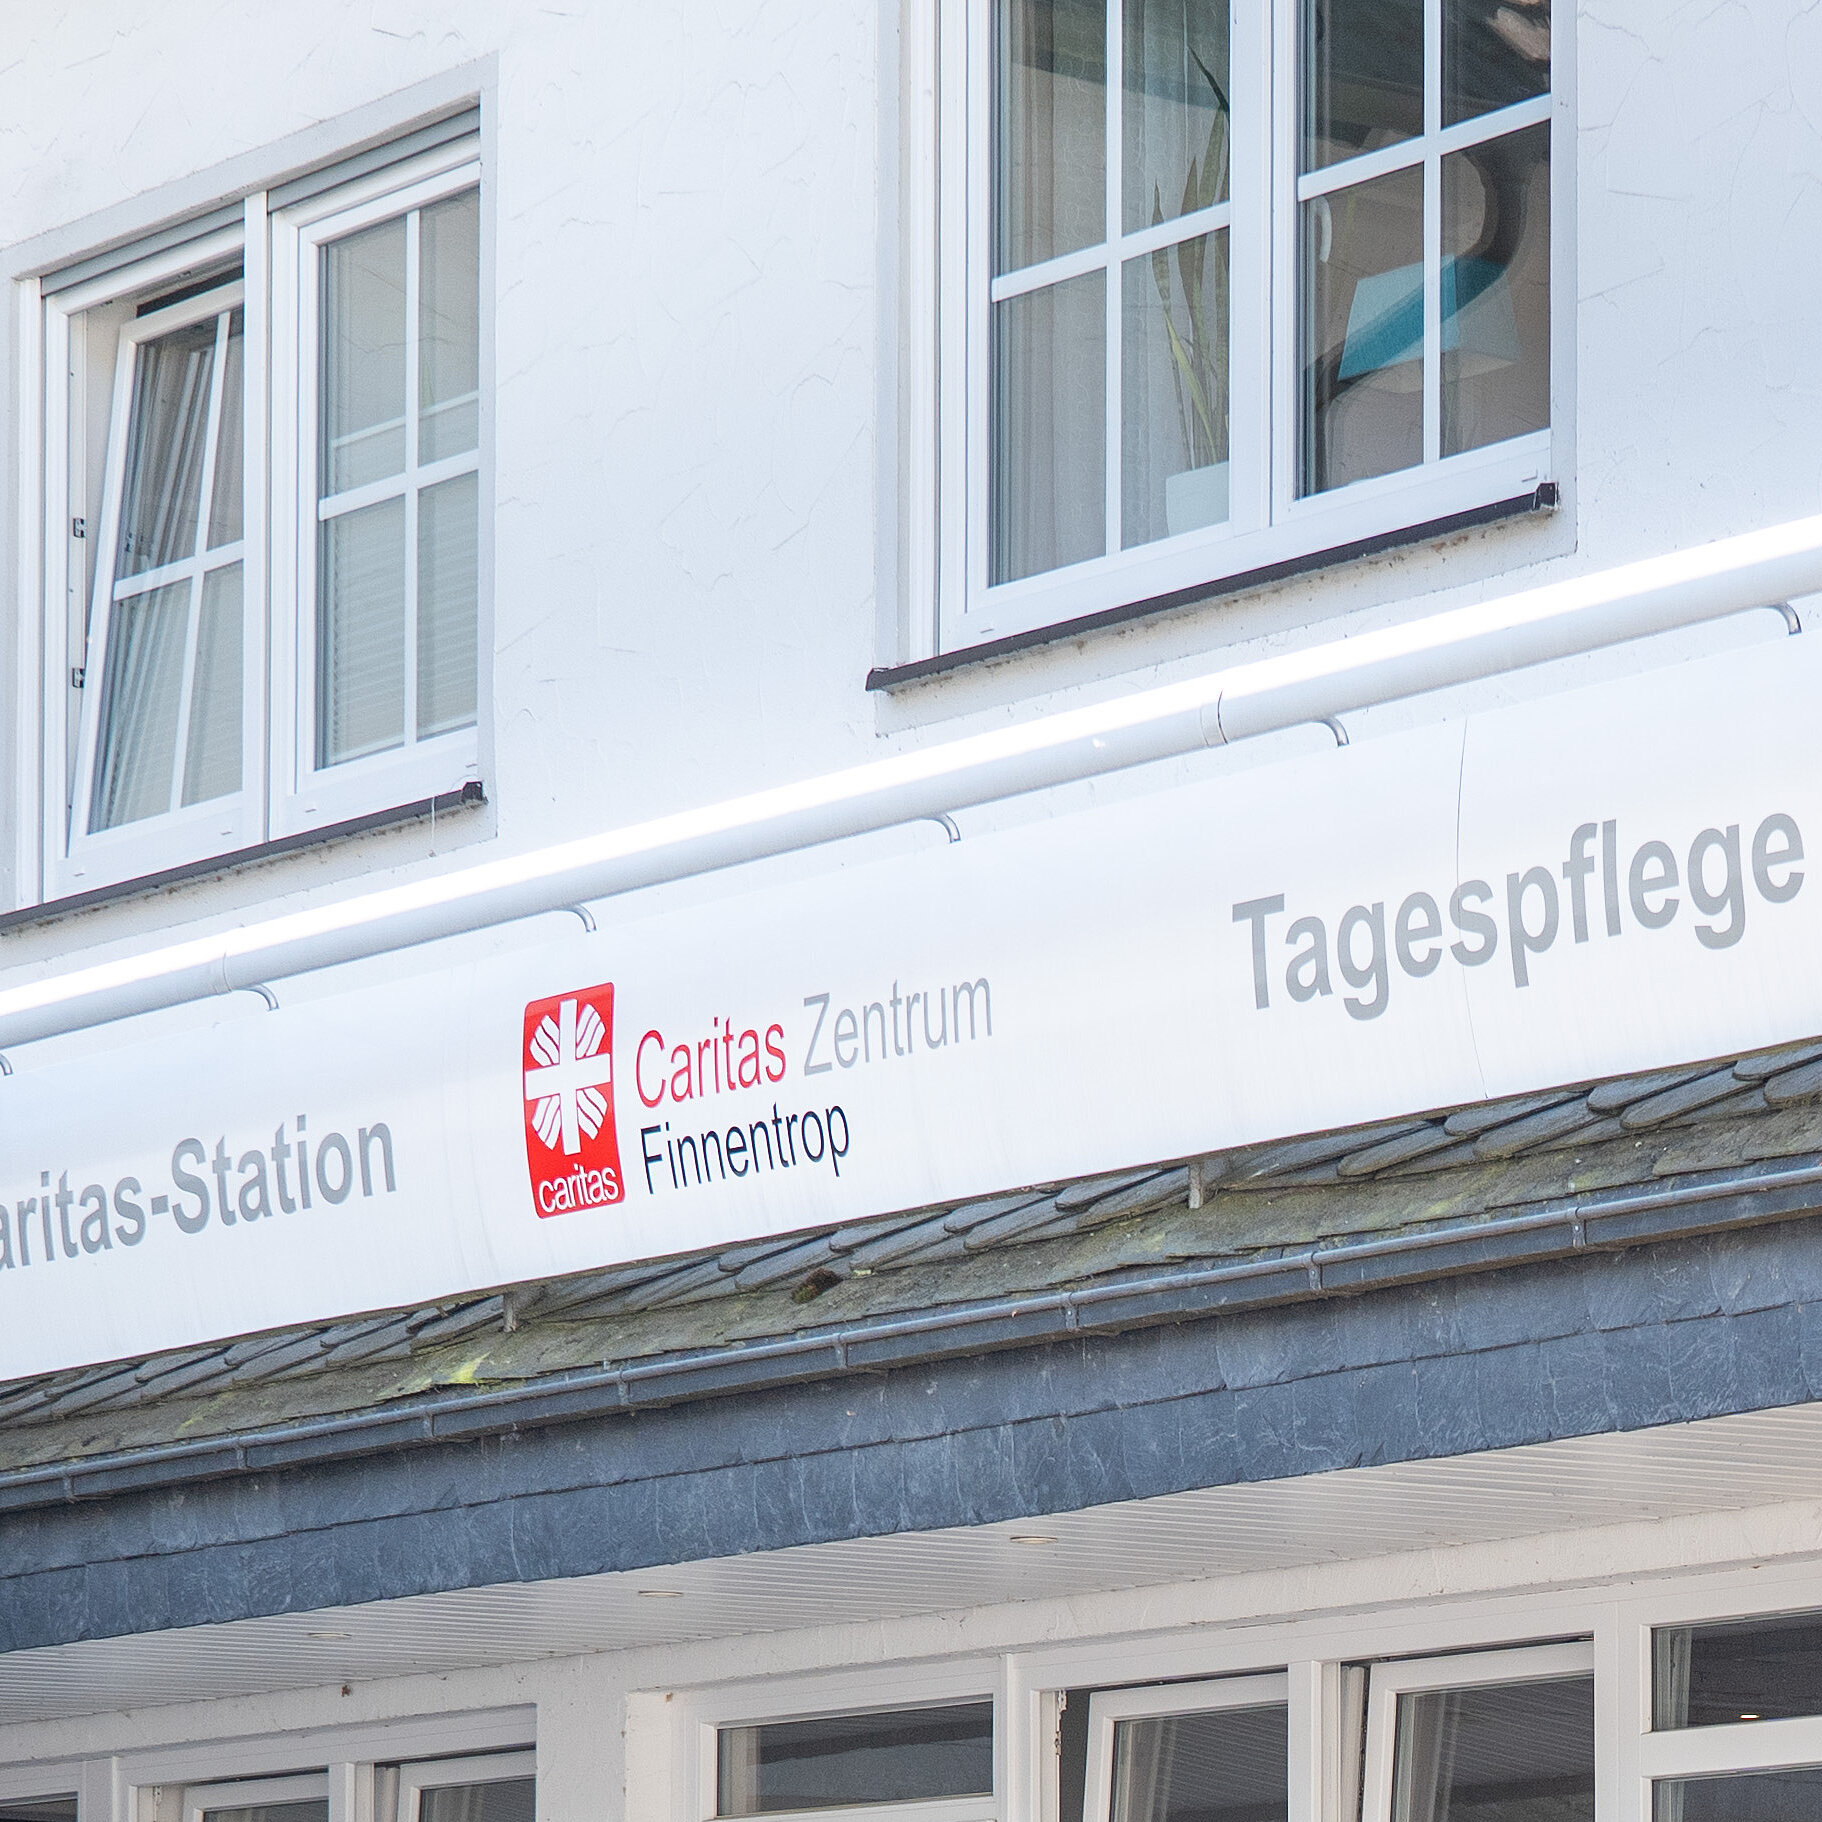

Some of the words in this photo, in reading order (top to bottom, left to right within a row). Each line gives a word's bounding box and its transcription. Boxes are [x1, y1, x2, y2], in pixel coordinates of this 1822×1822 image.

[1231, 812, 1806, 1022] Tagespflege
[635, 1016, 787, 1109] Caritas
[802, 977, 993, 1077] Zentrum
[538, 1163, 619, 1214] caritas
[640, 1101, 850, 1195] Finnentrop
